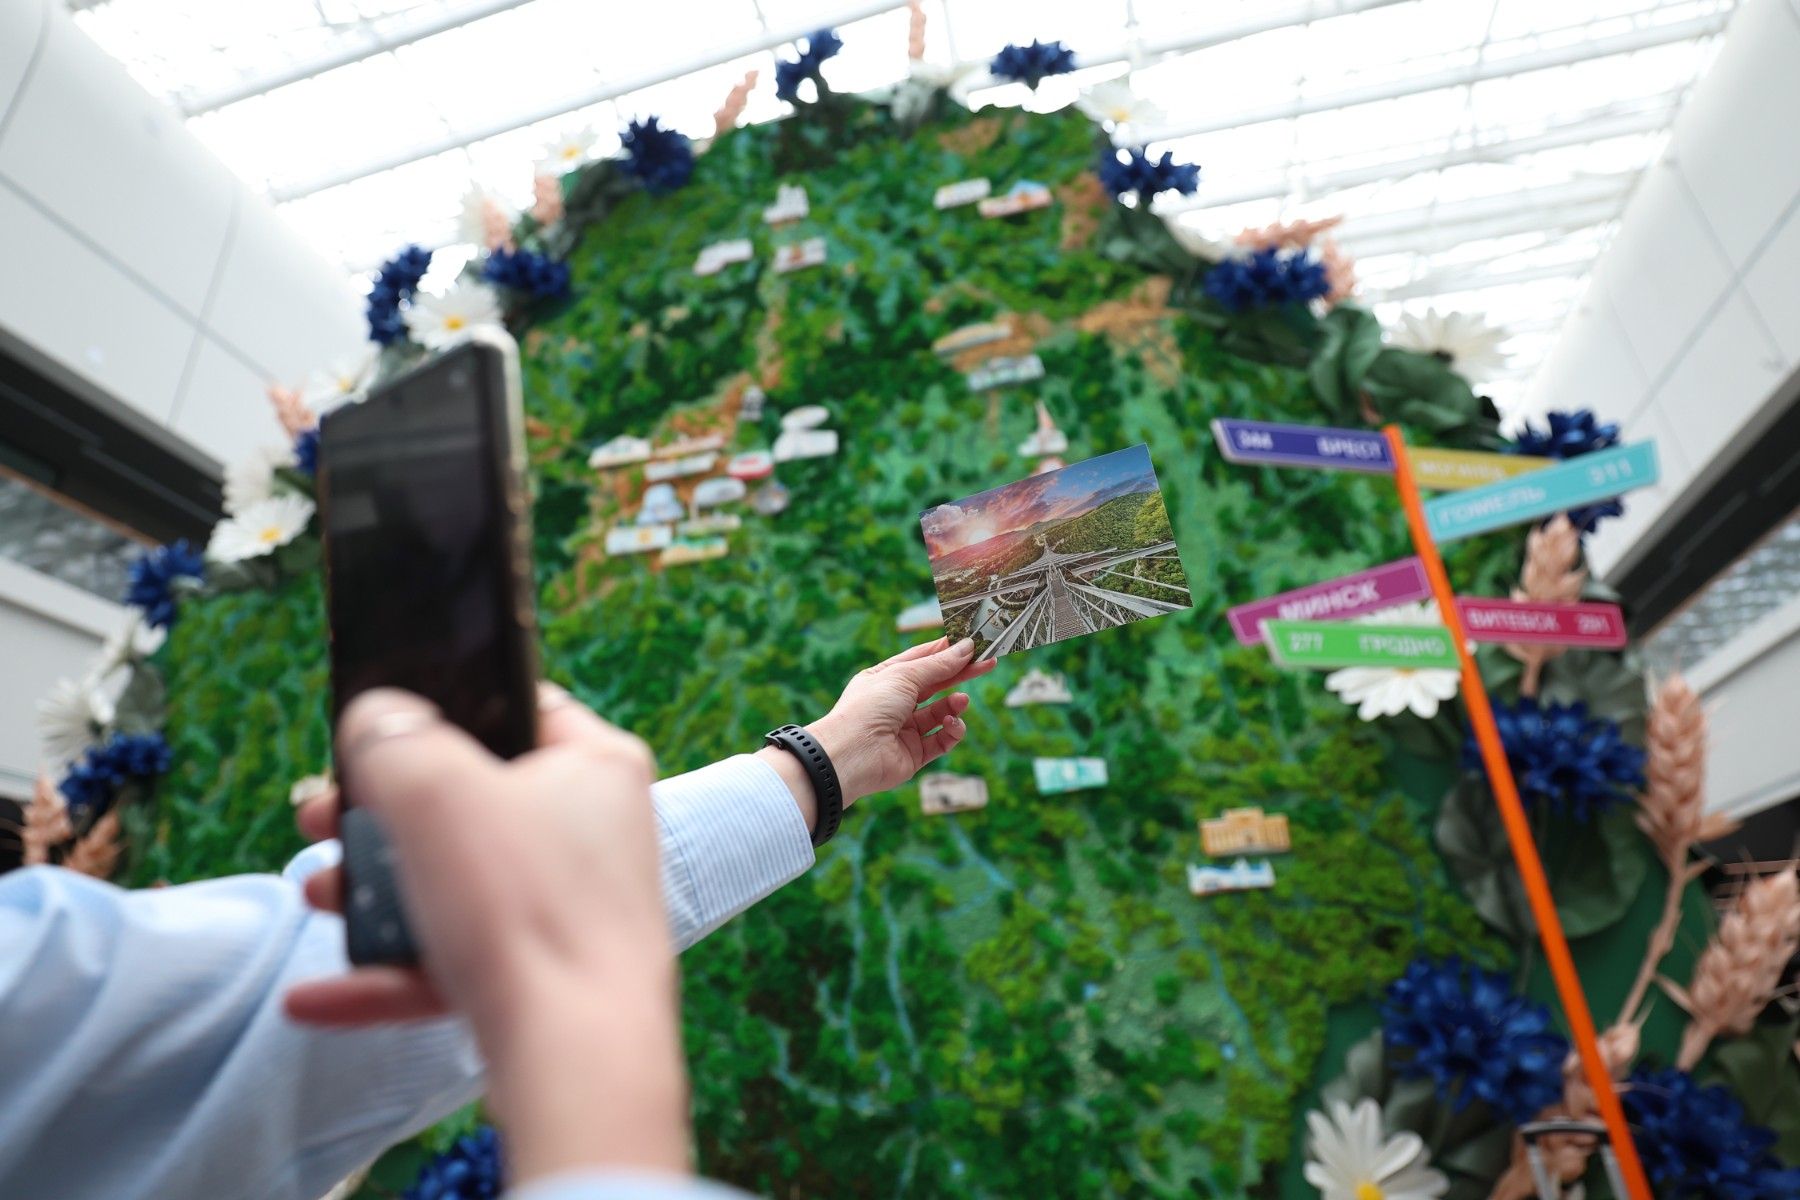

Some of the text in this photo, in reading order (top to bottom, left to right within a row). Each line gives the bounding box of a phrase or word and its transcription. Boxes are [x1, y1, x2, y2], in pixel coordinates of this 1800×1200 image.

[1317, 436, 1382, 459] БРЕСТ
[1440, 456, 1633, 527] ГОМЕЛЬ 311
[1277, 578, 1381, 620] МИНСК
[1468, 607, 1561, 633] ВИТЕБСК
[1289, 631, 1446, 657] 277 ГРОДНО
